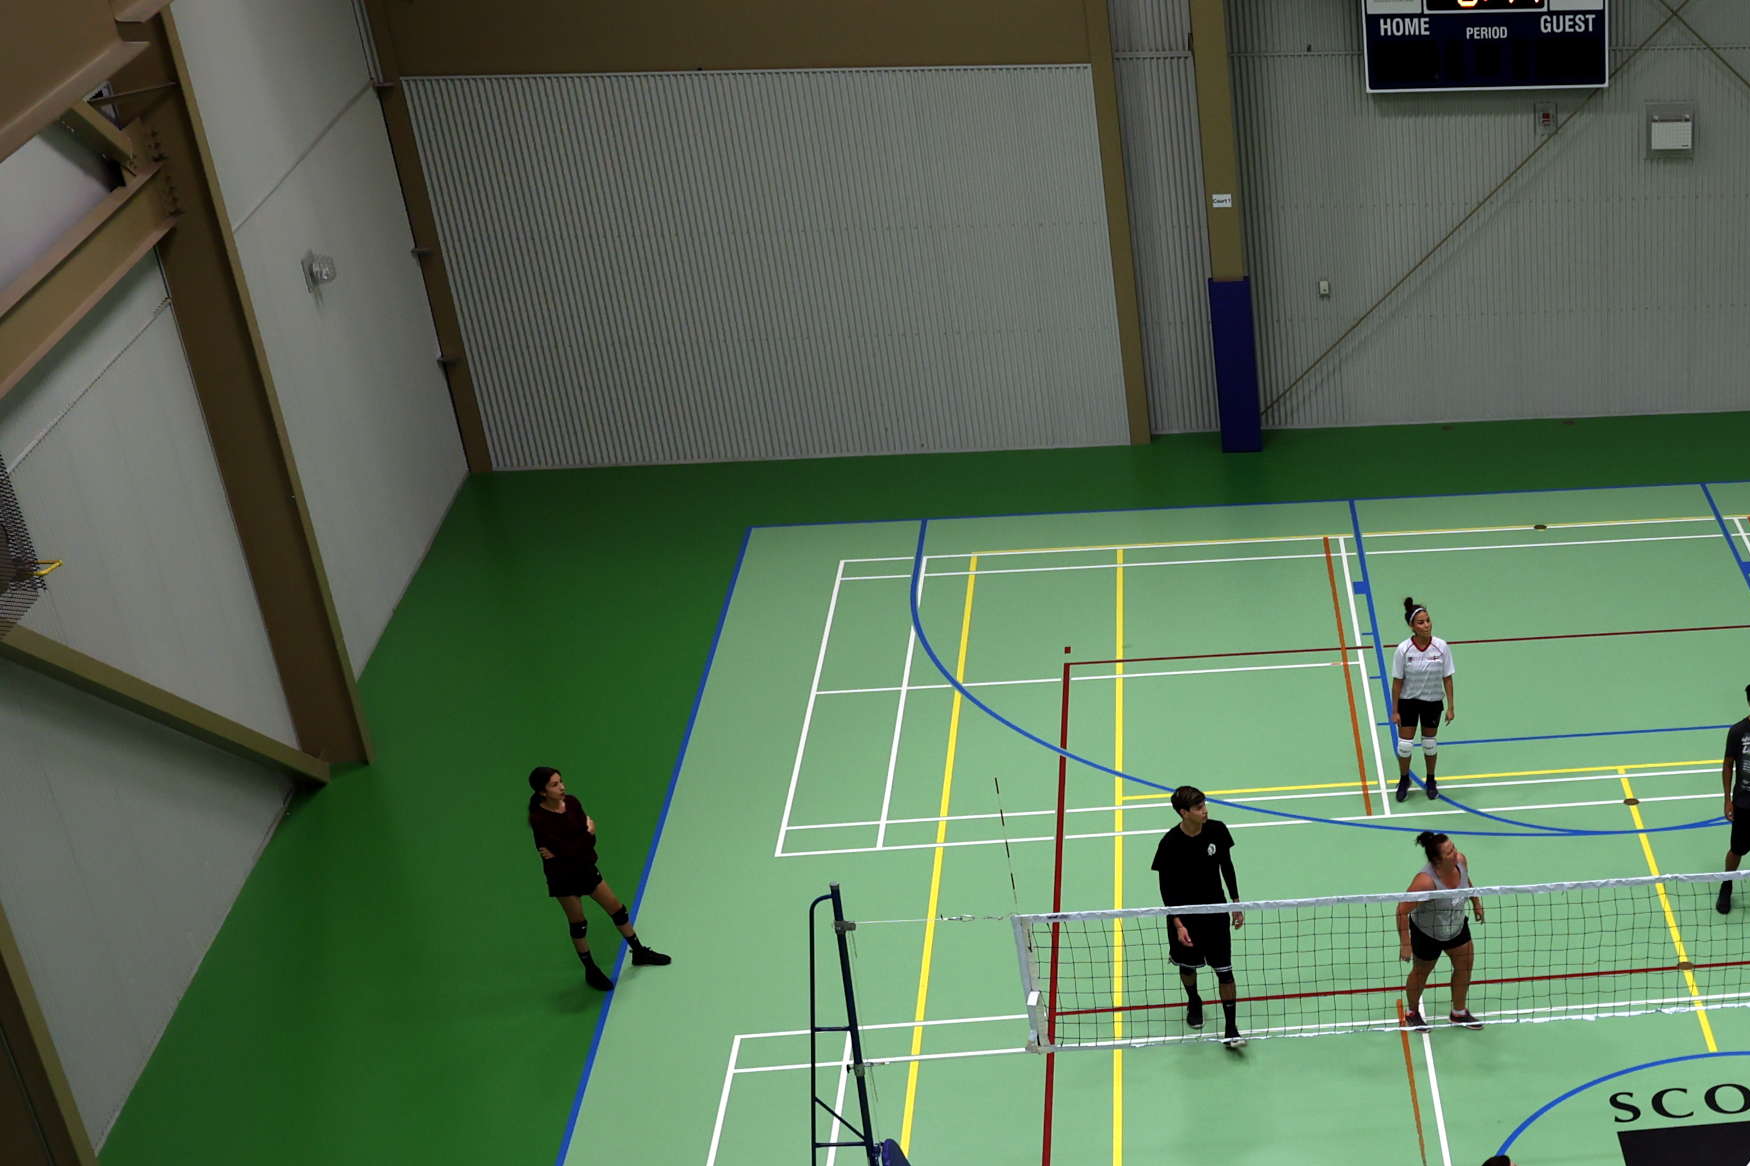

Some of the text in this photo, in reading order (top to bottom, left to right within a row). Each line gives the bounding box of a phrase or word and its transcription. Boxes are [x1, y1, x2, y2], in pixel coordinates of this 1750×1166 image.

[1380, 18, 1430, 36] HOME
[1466, 26, 1508, 39] PERIOD
[1540, 15, 1596, 33] GUEST
